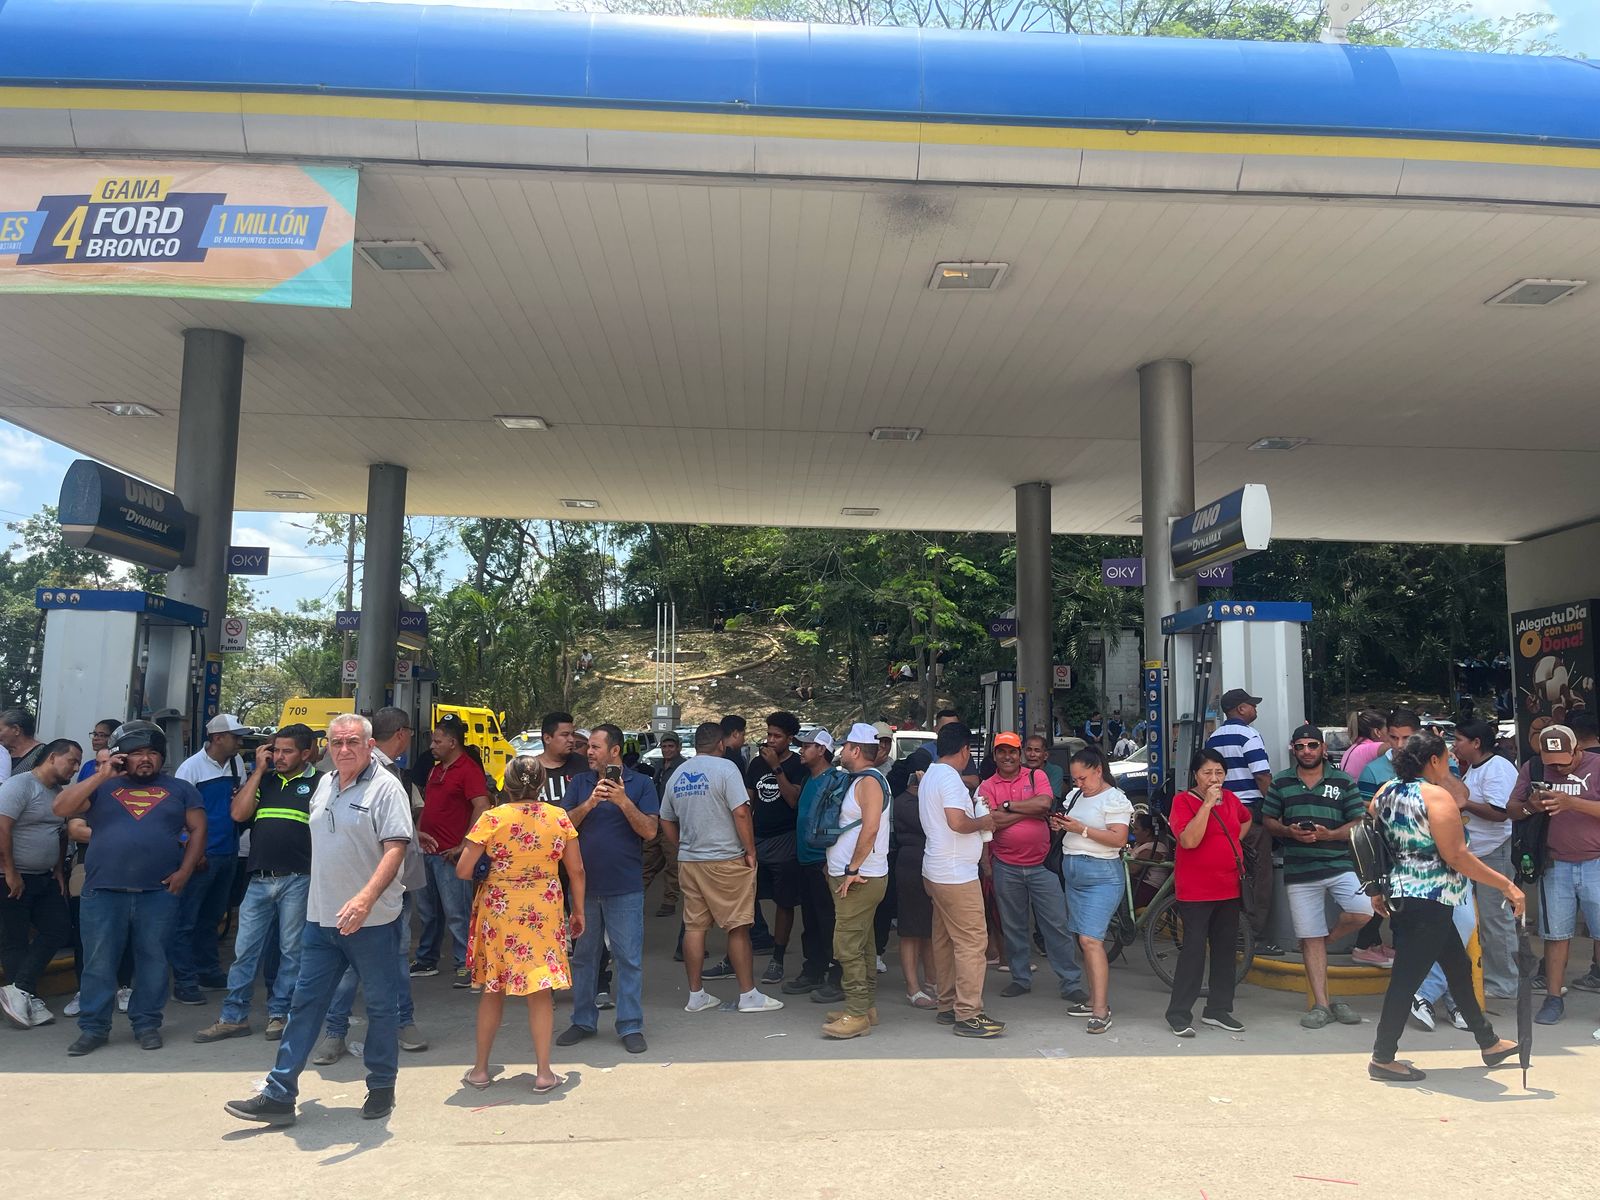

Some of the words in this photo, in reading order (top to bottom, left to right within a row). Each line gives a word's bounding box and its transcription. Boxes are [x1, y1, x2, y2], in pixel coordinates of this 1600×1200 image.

[101, 179, 160, 200] GANA
[92, 206, 184, 235] FORD
[218, 212, 228, 234] 1
[233, 208, 309, 236] MILLÓN
[53, 206, 89, 259] 4
[223, 236, 267, 245] MULTIPUNTOS
[86, 238, 181, 258] BRONCO
[125, 477, 165, 512] UNO
[126, 509, 170, 534] DYNAMAX
[1191, 503, 1221, 534] UNO
[231, 554, 262, 568] OKY
[1106, 566, 1136, 579] OKY
[202, 611, 208, 624] 5
[1207, 605, 1213, 619] 2
[1565, 604, 1587, 621] Día
[338, 616, 359, 625] OKY
[401, 616, 421, 626] OKY
[991, 623, 1012, 633] OKY
[1544, 625, 1561, 637] con
[1564, 621, 1583, 633] una
[1542, 631, 1584, 653] Dona!
[289, 707, 308, 716] 709
